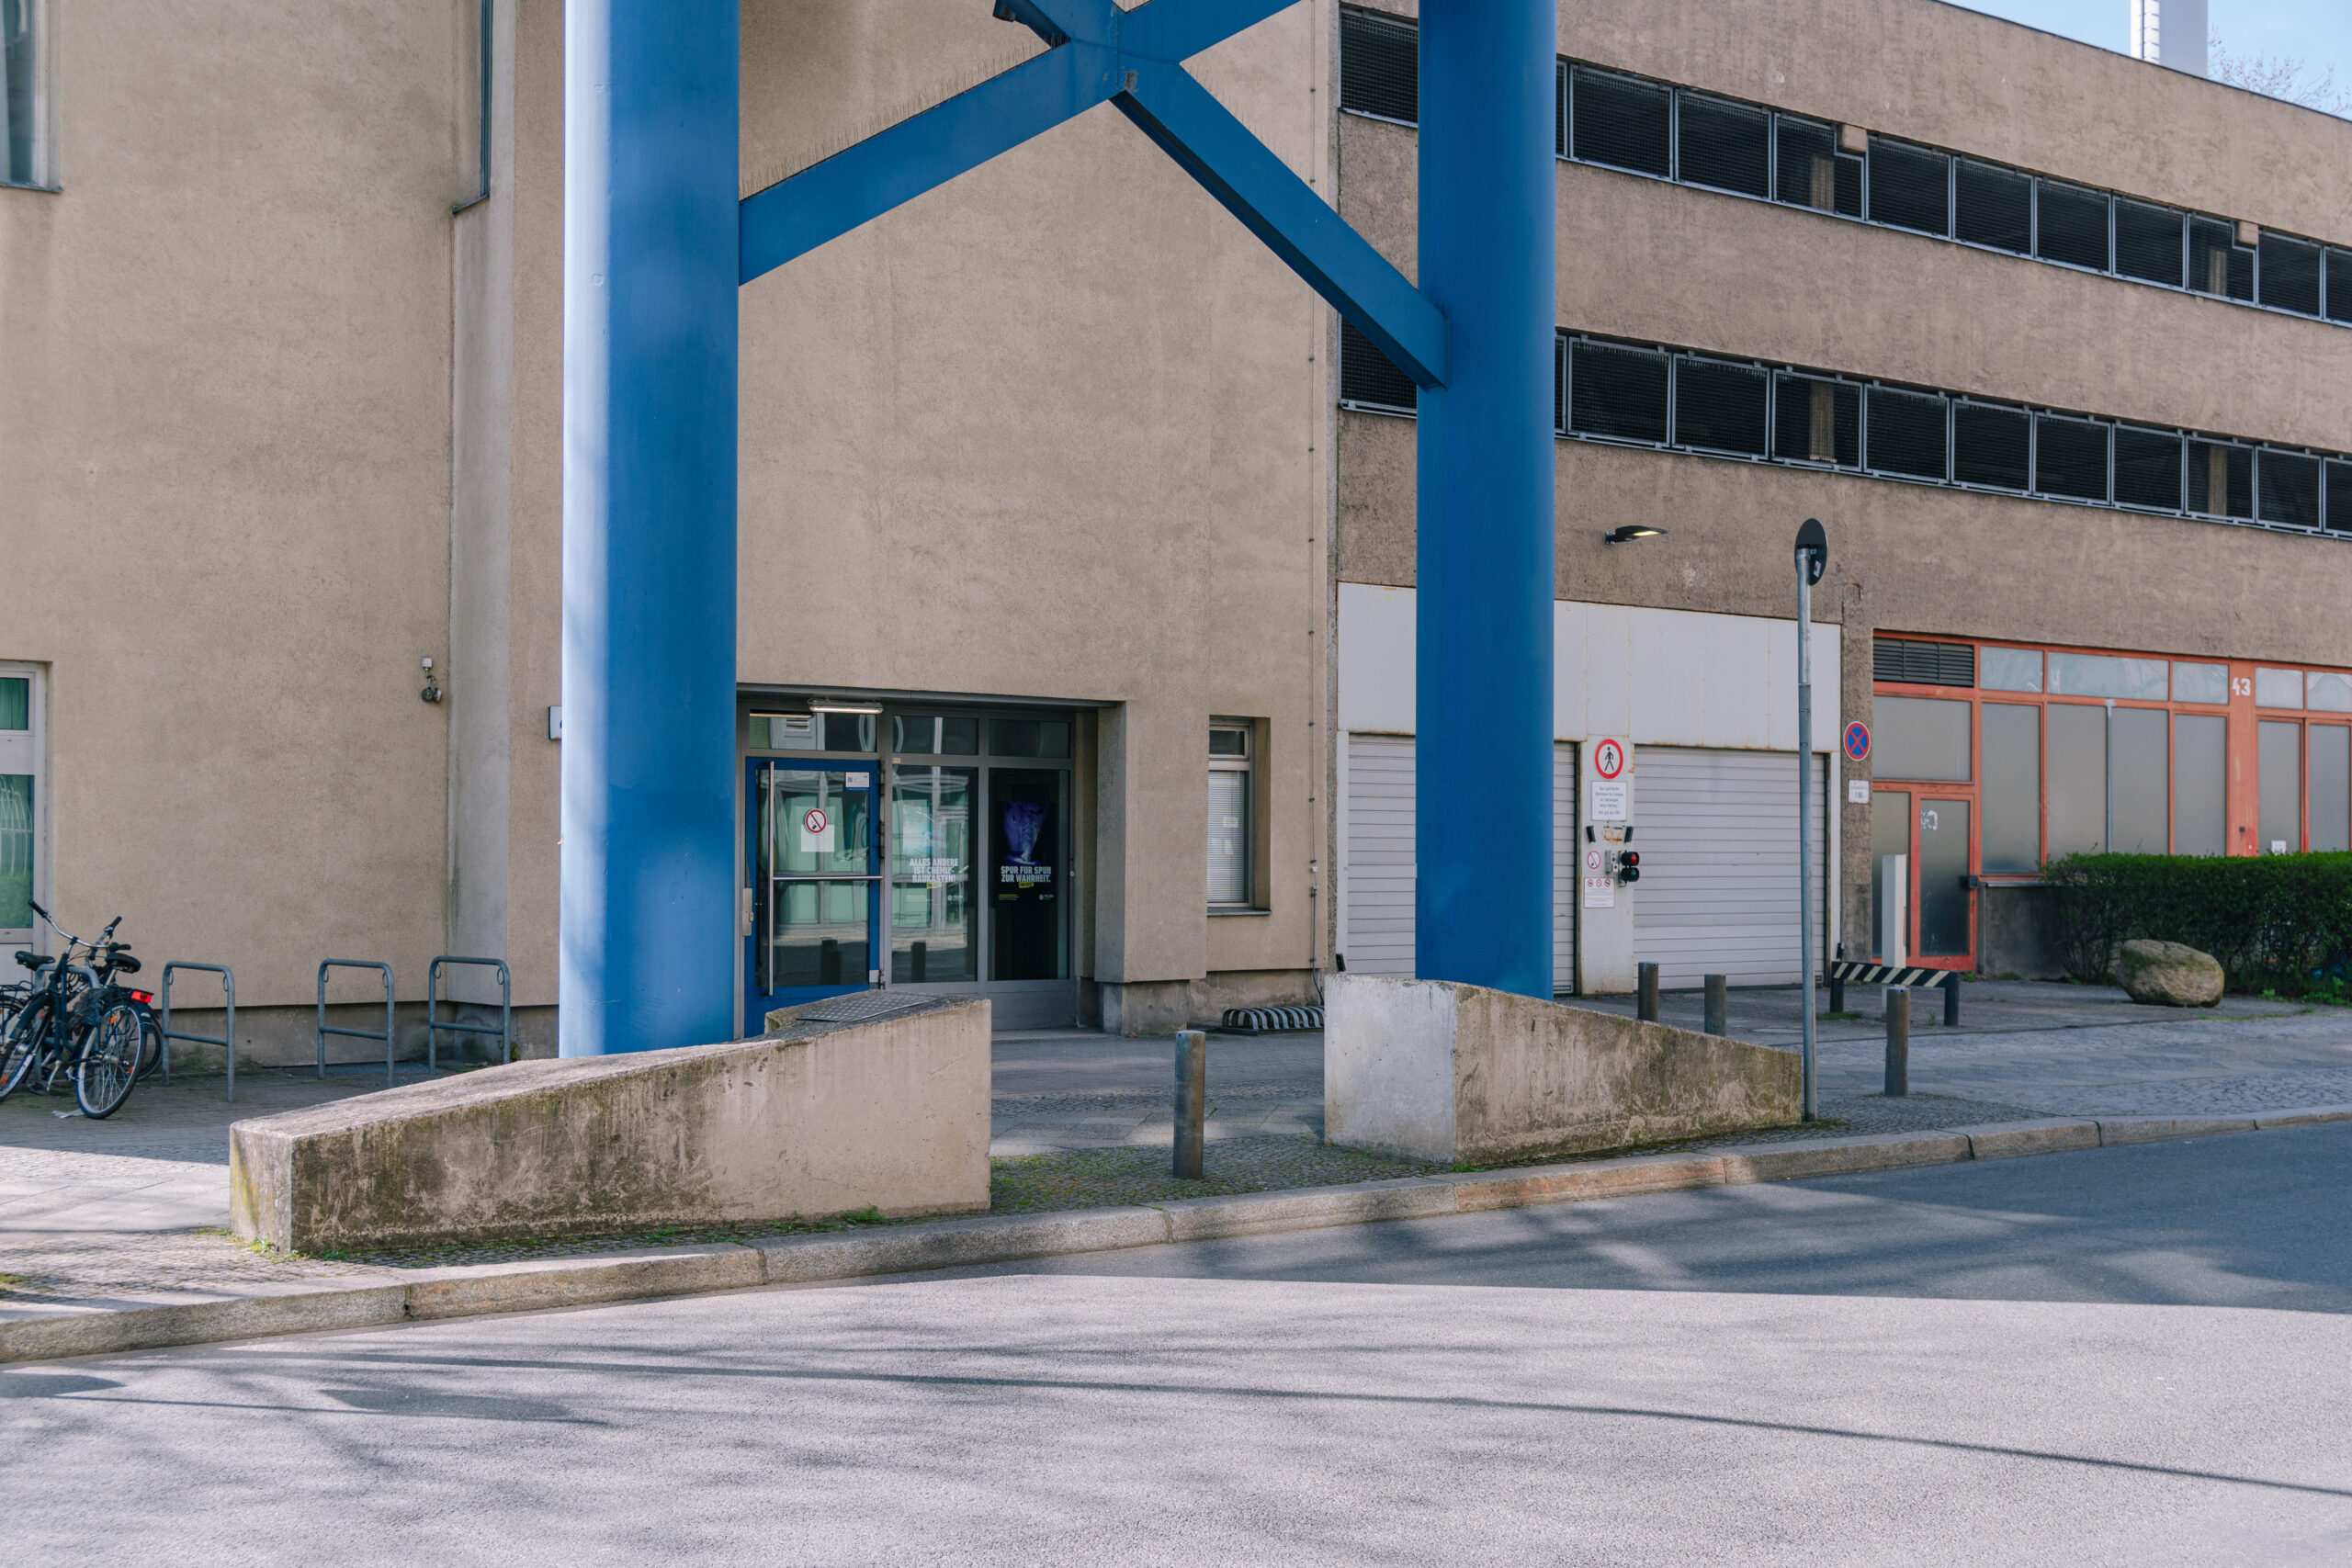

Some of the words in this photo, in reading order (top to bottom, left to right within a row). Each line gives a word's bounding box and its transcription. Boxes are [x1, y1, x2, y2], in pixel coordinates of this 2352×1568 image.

[2232, 676, 2251, 696] 43
[910, 858, 931, 866] ALLES
[932, 858, 959, 866] ANDERE
[914, 866, 925, 874] IST
[1001, 865, 1019, 874] SPUR
[1034, 866, 1052, 874] SPUR
[1001, 874, 1014, 883] ZUR
[1015, 874, 1051, 883] WAHRHEIT.
